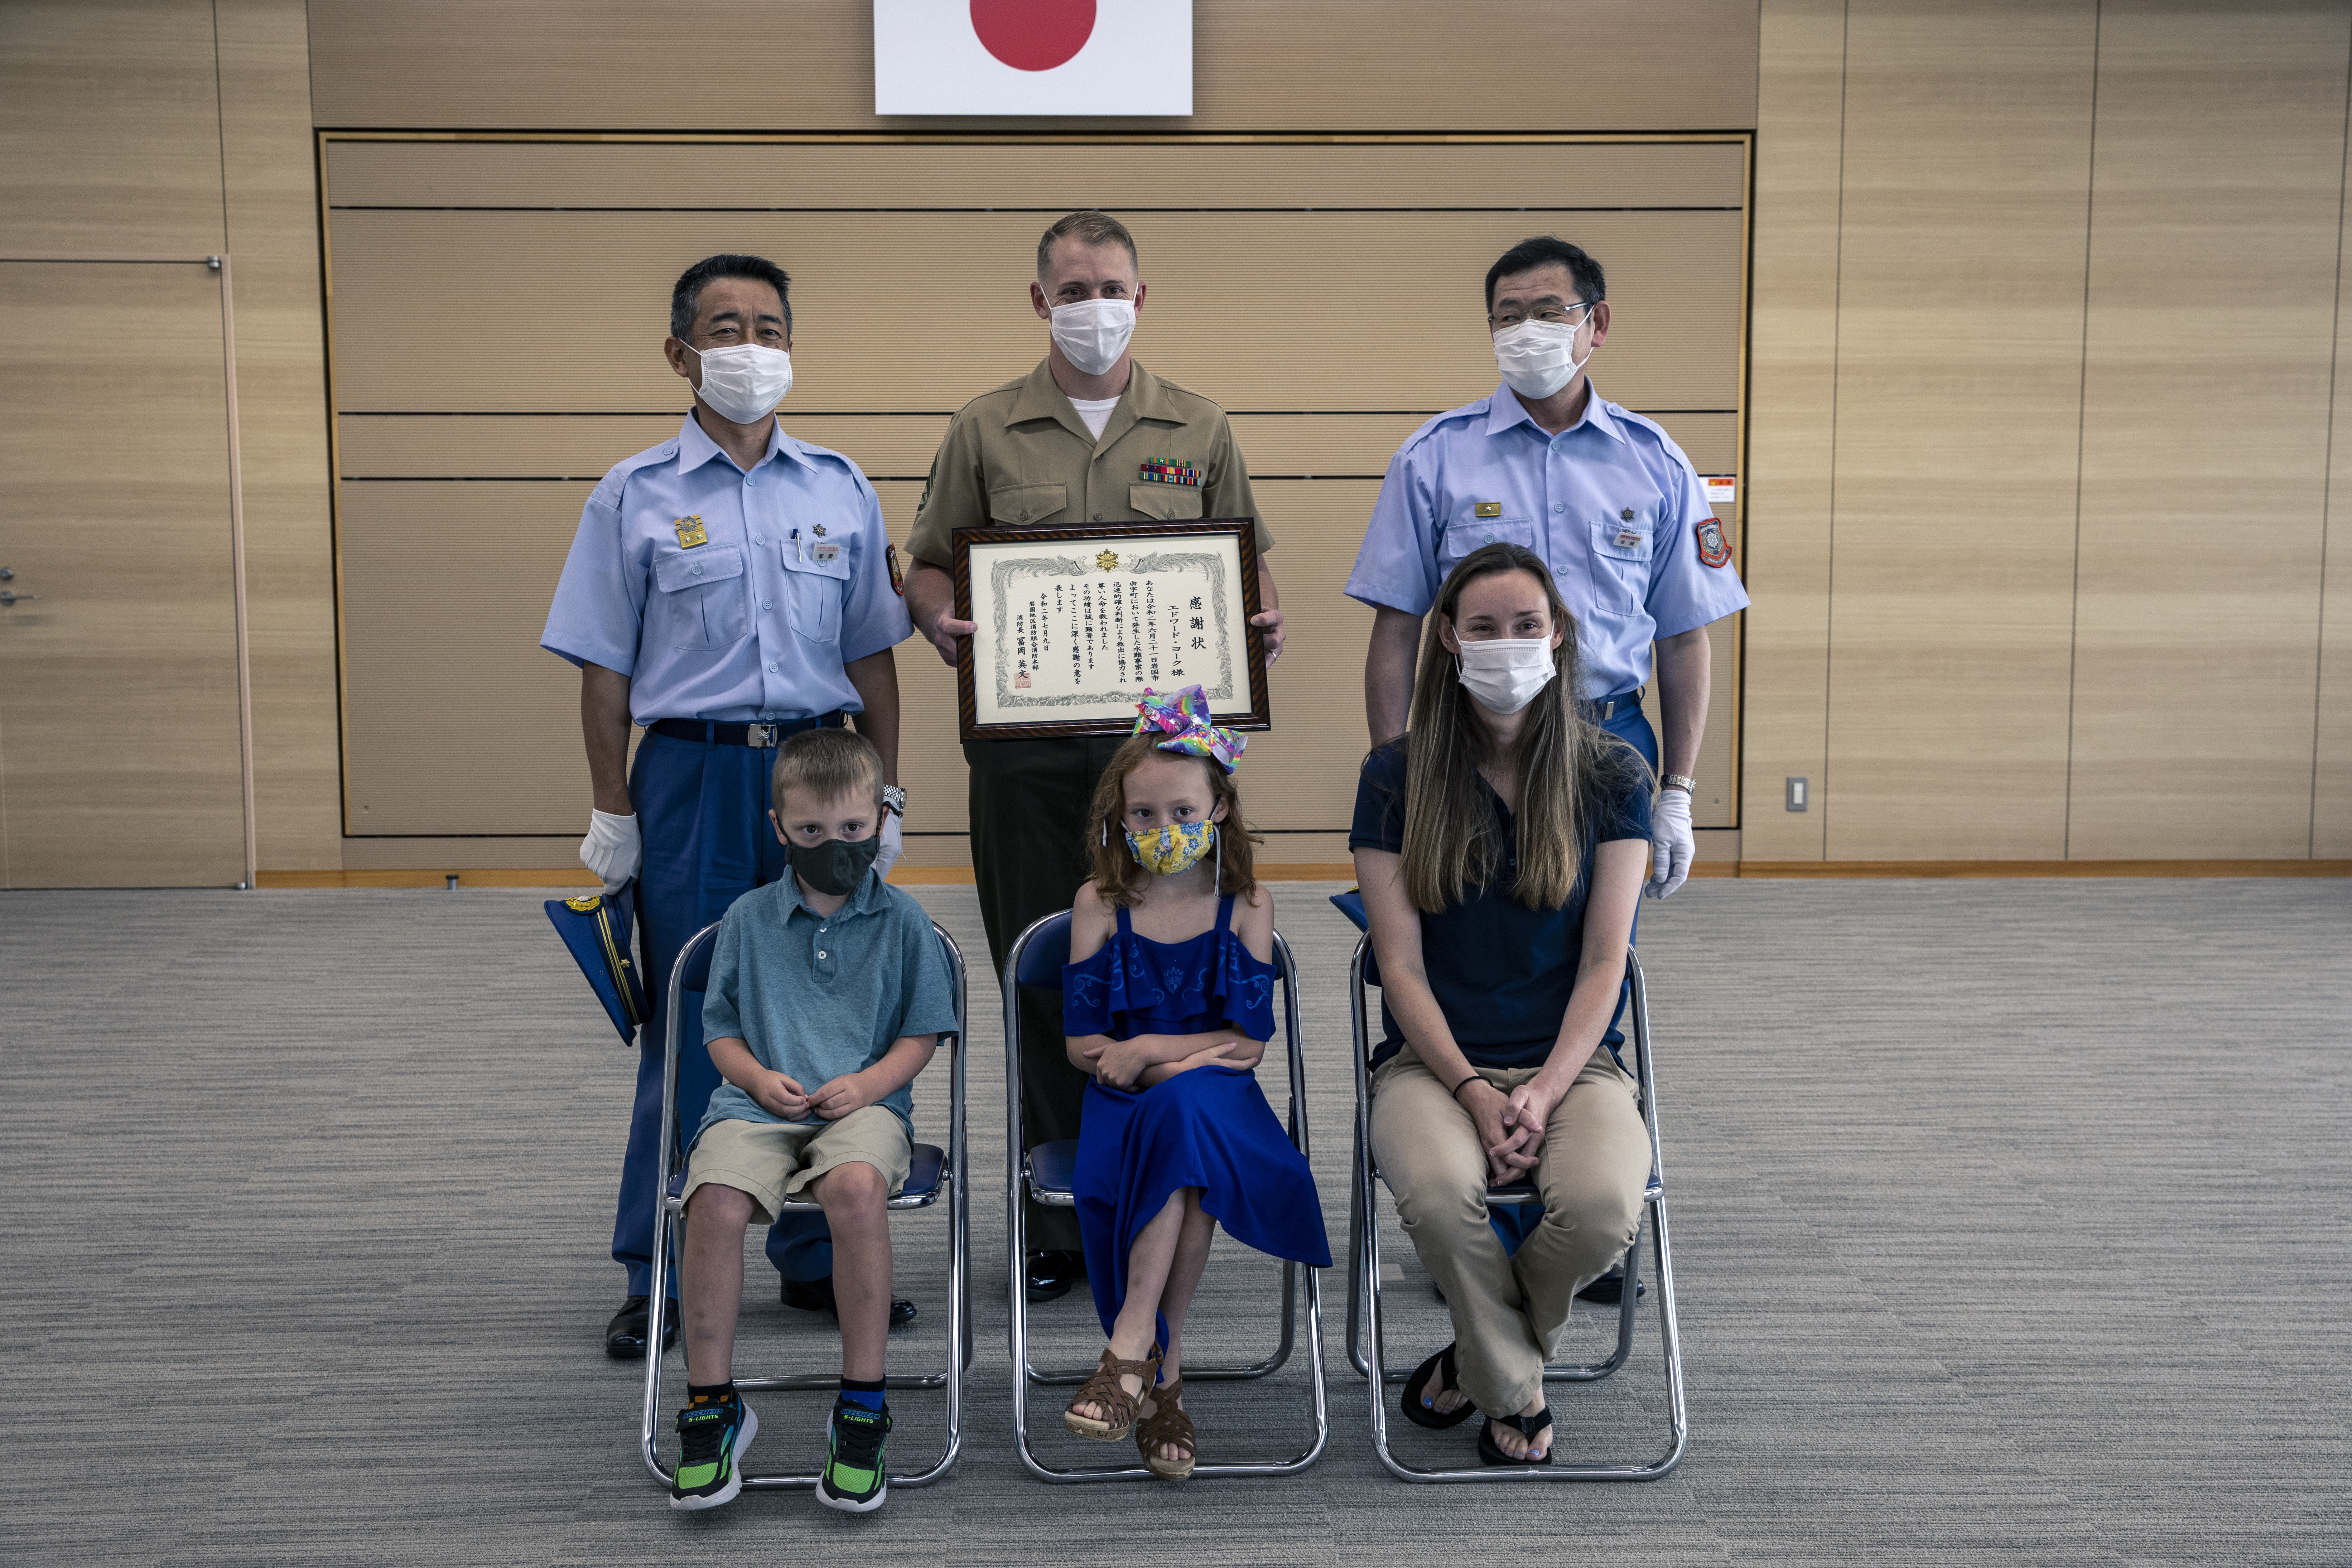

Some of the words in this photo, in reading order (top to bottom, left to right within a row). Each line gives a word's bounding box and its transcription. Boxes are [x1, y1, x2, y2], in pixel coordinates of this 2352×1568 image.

[1040, 593, 1050, 651] 令和二年七月九日
[1055, 584, 1063, 613] 表します
[1097, 582, 1109, 650] 尊い人命を救われました
[1189, 596, 1206, 650] 感謝状
[1029, 601, 1039, 671] 岩国地区消防組合消防本部
[1069, 584, 1081, 685] よってここに深く感謝の意を
[1113, 582, 1127, 683] 迅速的確な判断により救出に協力され
[1129, 581, 1144, 682] 由宇町において発生した水難事案の際
[1146, 580, 1160, 681] あなたは令和二年六月二十一日岩国市
[1168, 605, 1185, 676] エドワード・ヨーク様
[1018, 659, 1028, 679] 英文
[683, 1408, 723, 1419] SKECHERS
[840, 1408, 881, 1419] SKECHERS
[843, 1415, 874, 1423] S-LIGHTS
